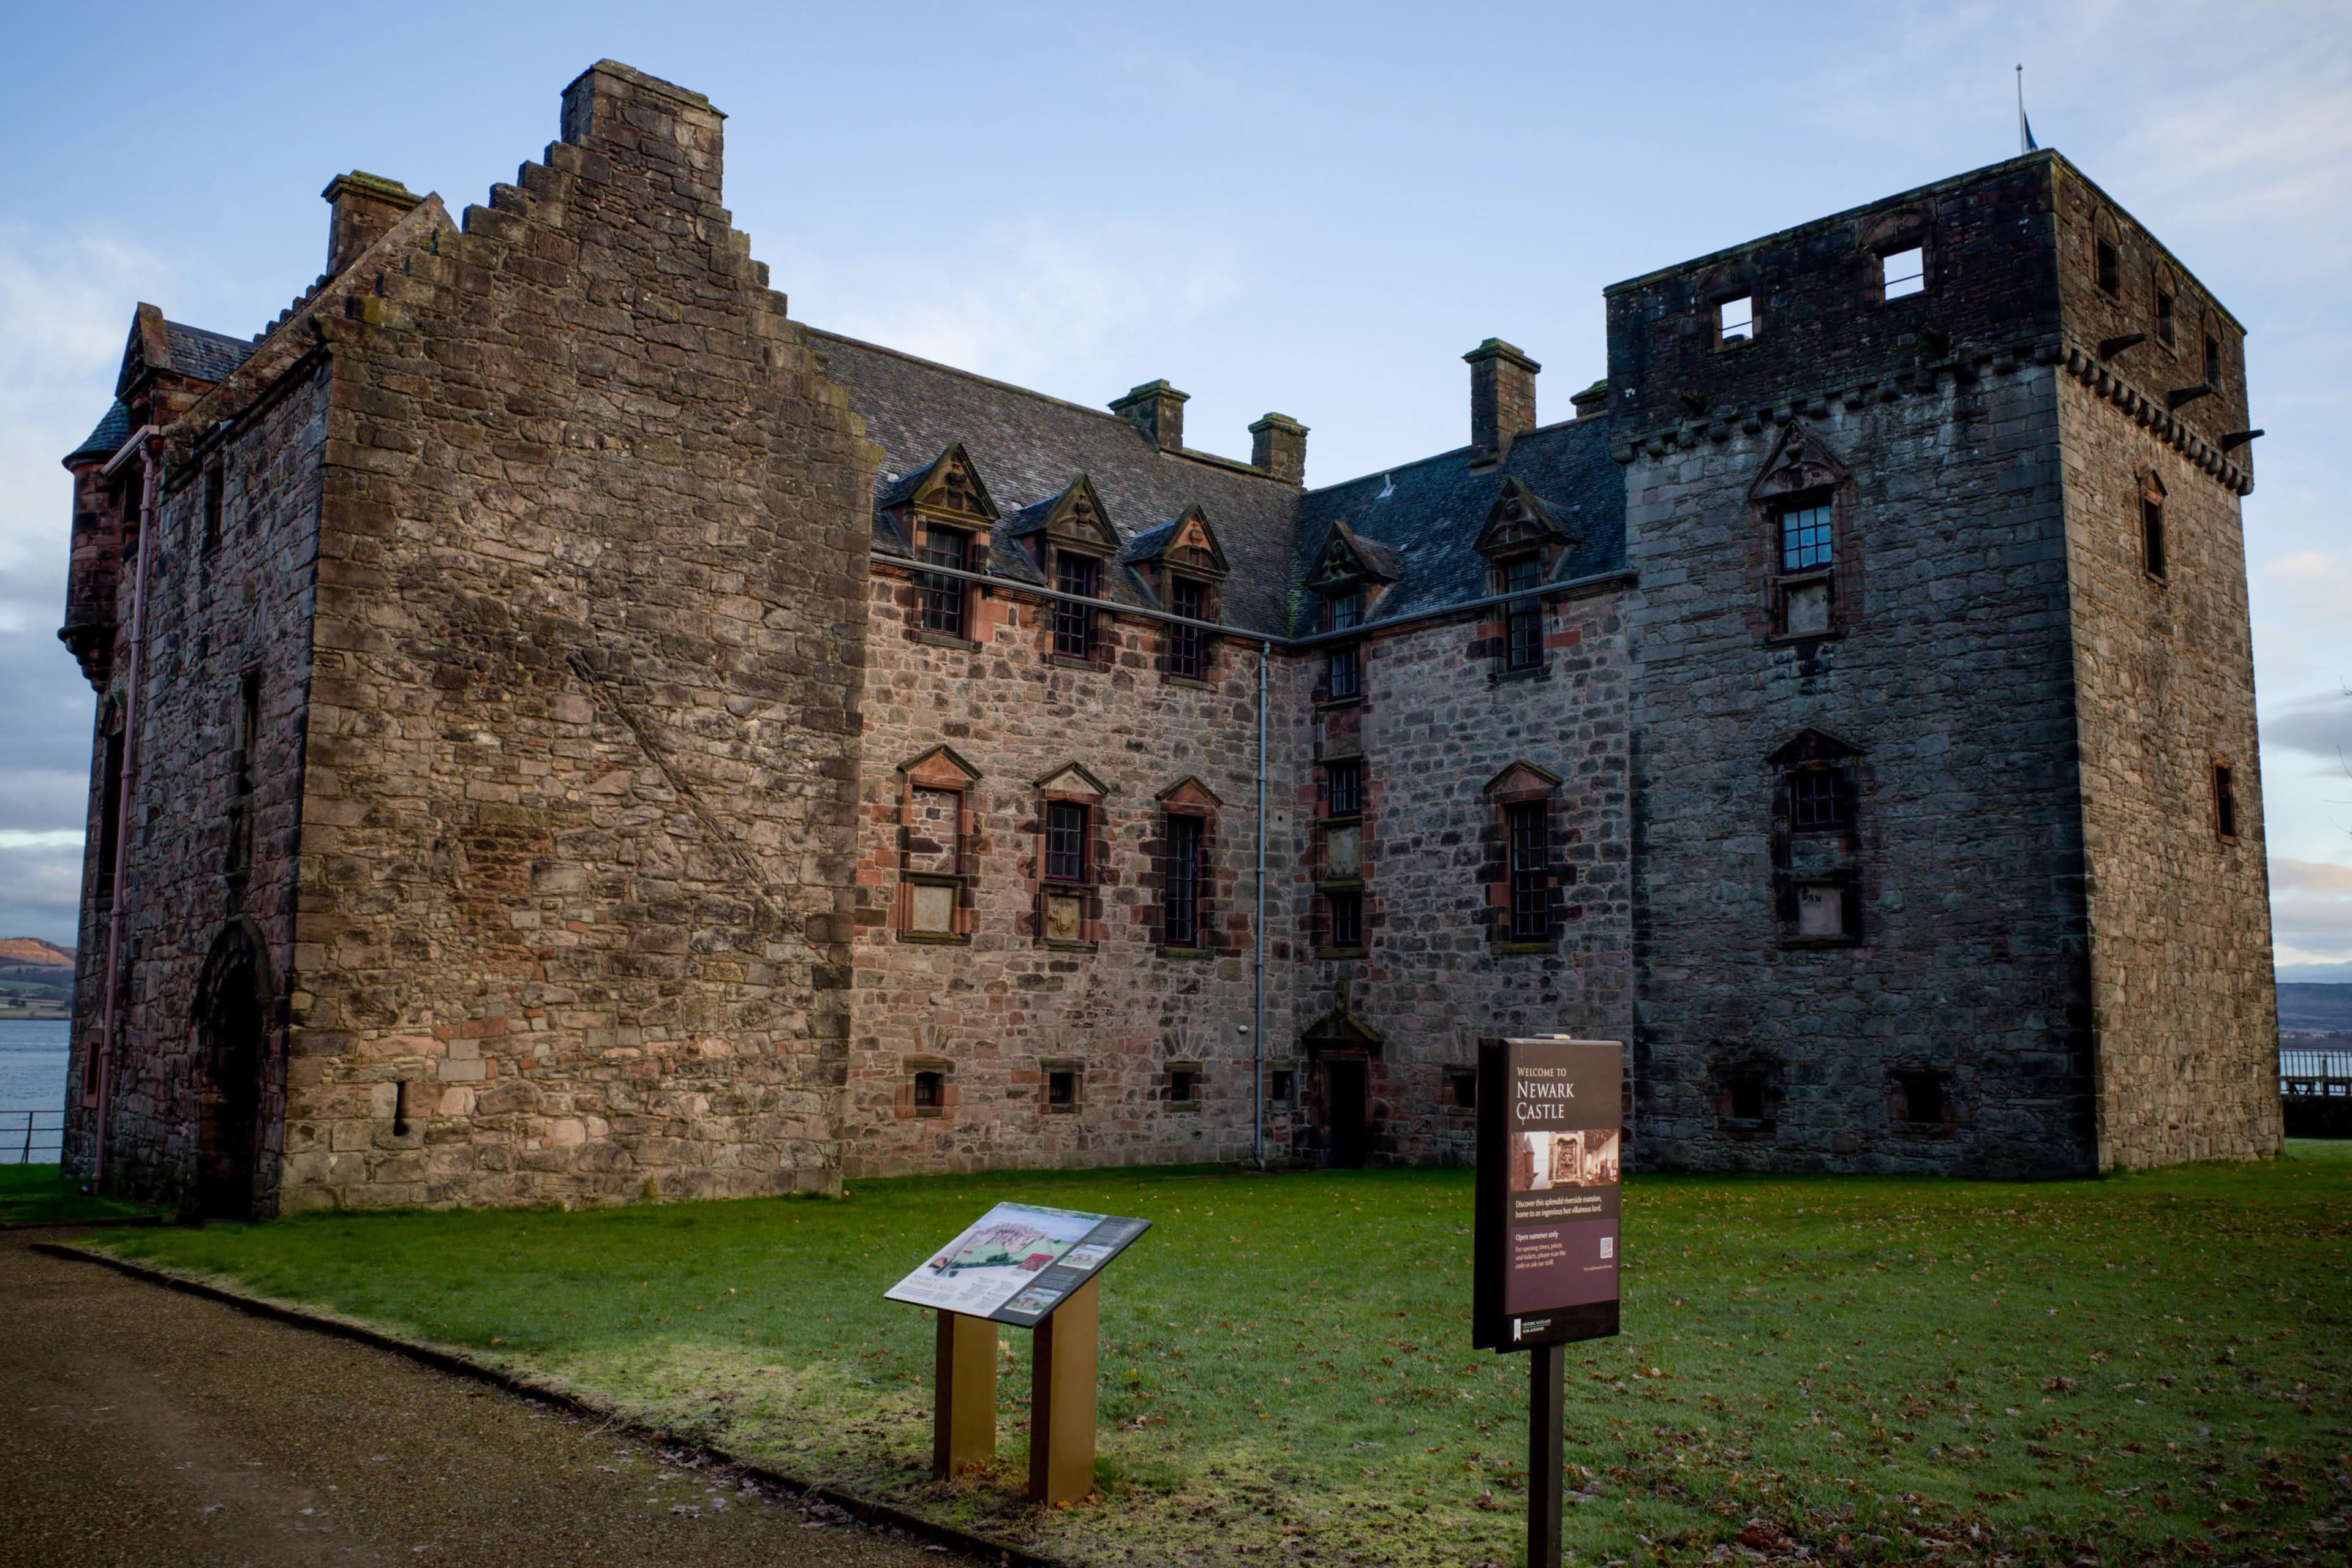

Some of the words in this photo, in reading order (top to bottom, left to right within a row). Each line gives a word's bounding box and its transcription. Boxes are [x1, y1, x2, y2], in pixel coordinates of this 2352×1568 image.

[1517, 1067, 1554, 1077] WELCOME
[1556, 1068, 1567, 1077] TO
[1517, 1081, 1575, 1098] NEWARK
[1517, 1102, 1564, 1119] CASTLE
[1515, 1200, 1535, 1208] Discover
[1545, 1197, 1564, 1207] splendid
[1564, 1196, 1582, 1204] riverside
[1542, 1208, 1563, 1218] ingenious
[1515, 1234, 1529, 1242] Open
[1548, 1230, 1558, 1240] only
